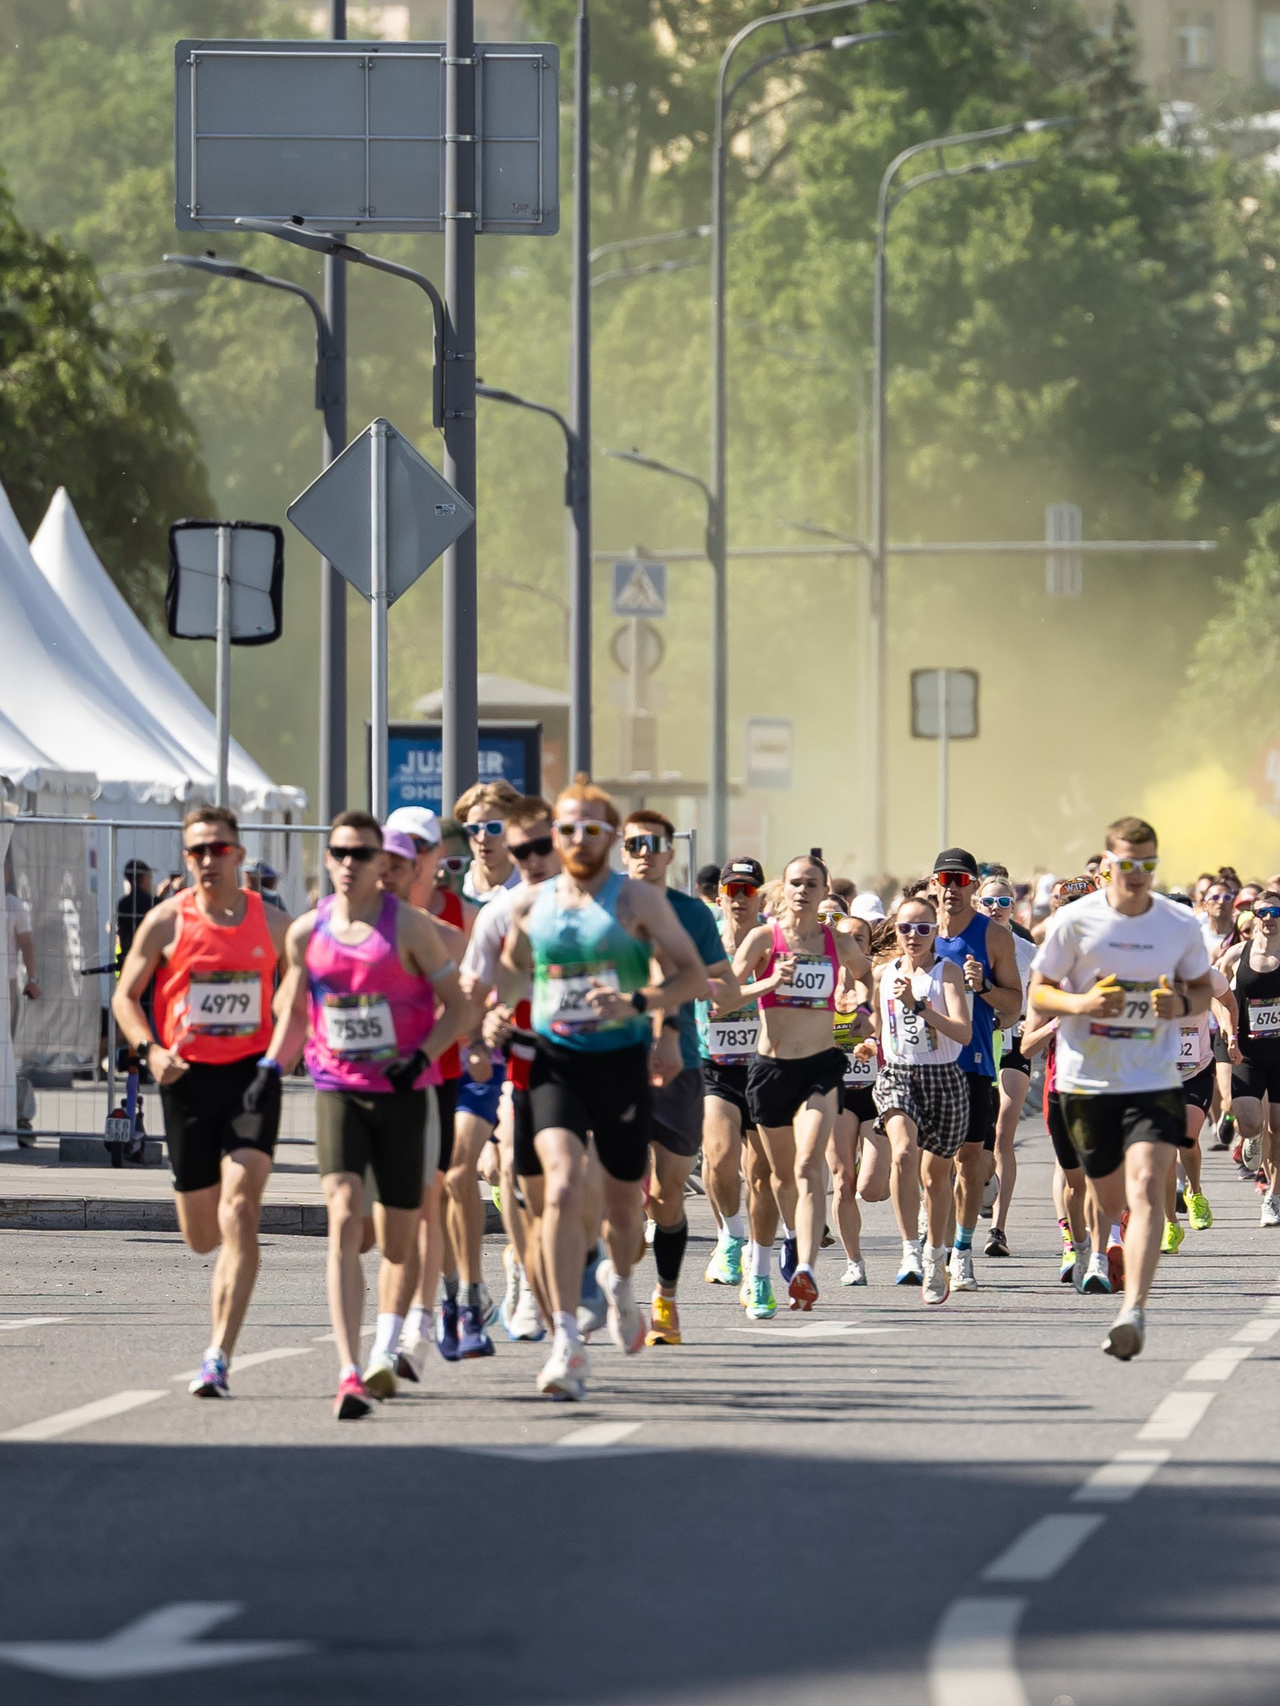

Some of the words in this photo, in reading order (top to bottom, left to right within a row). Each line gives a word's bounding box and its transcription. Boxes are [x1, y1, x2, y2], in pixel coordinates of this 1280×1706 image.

[200, 992, 251, 1015] 4979
[333, 1016, 385, 1040] 7535
[716, 1028, 758, 1047] 7837
